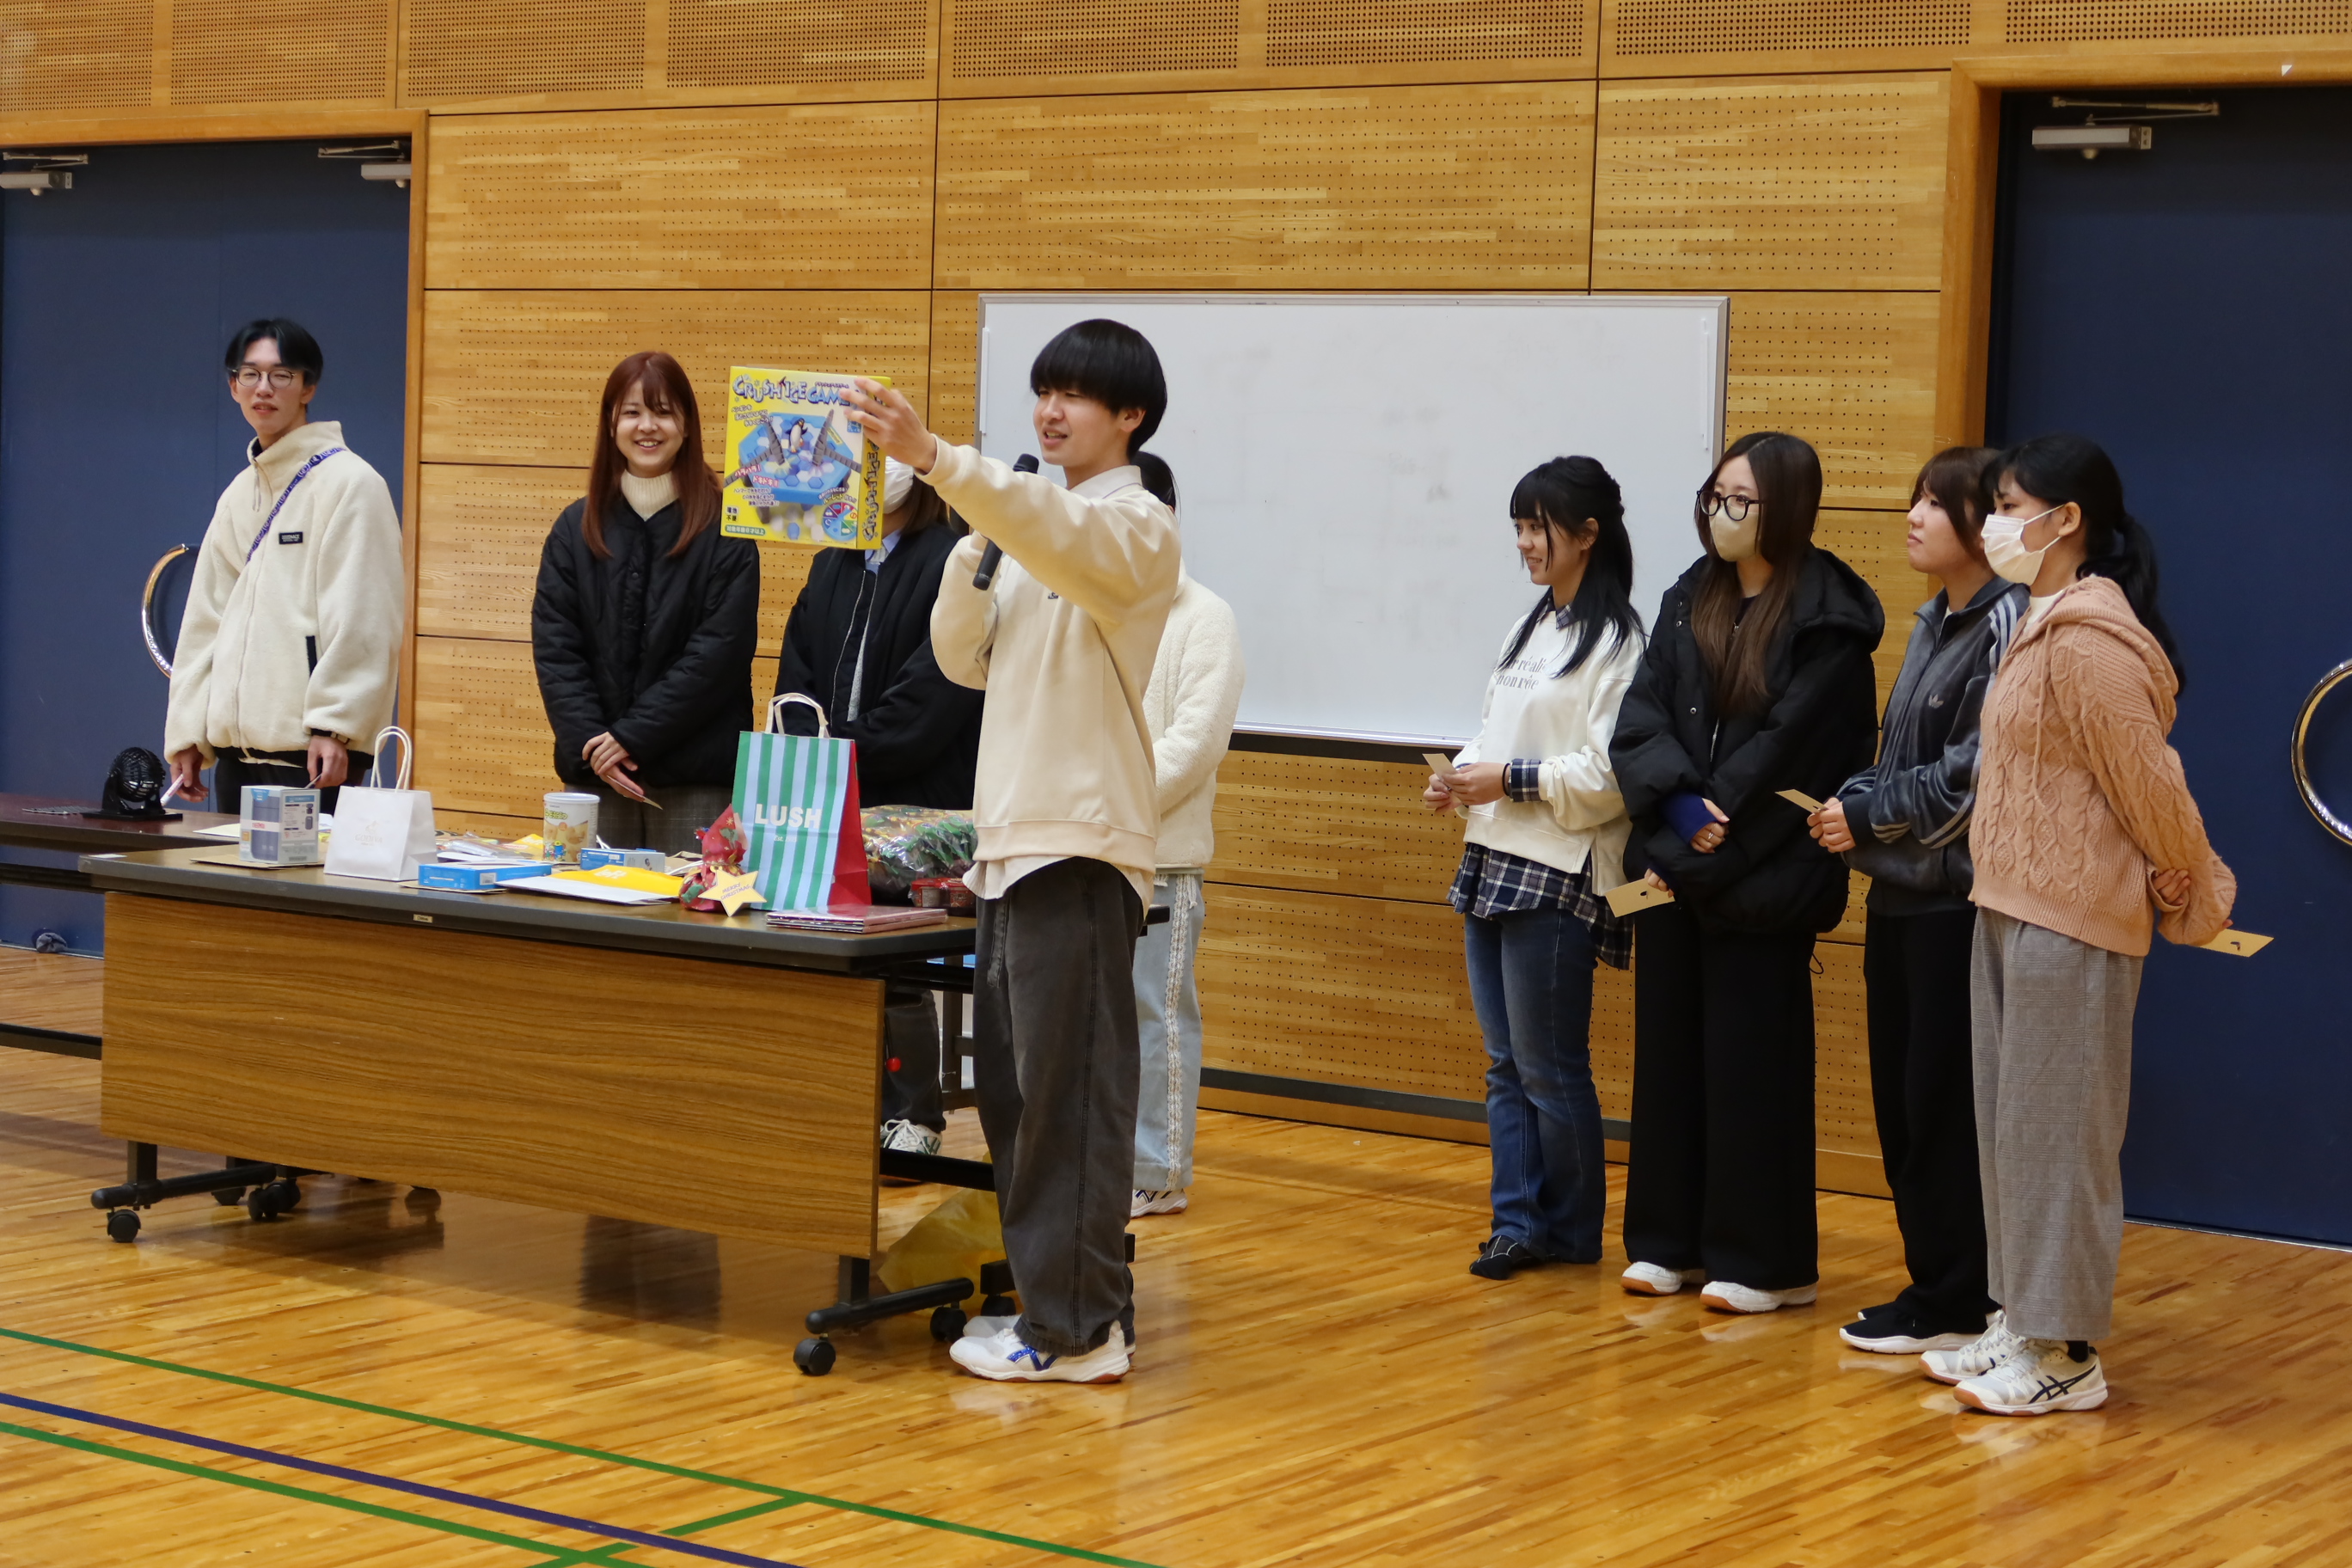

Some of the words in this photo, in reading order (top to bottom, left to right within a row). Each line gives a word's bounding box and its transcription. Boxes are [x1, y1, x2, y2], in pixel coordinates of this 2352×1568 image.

[732, 376, 782, 402] CRUSH
[783, 380, 807, 403] ICE
[866, 452, 880, 479] ICE
[862, 481, 879, 542] CRUSH
[755, 803, 822, 830] LUSH
